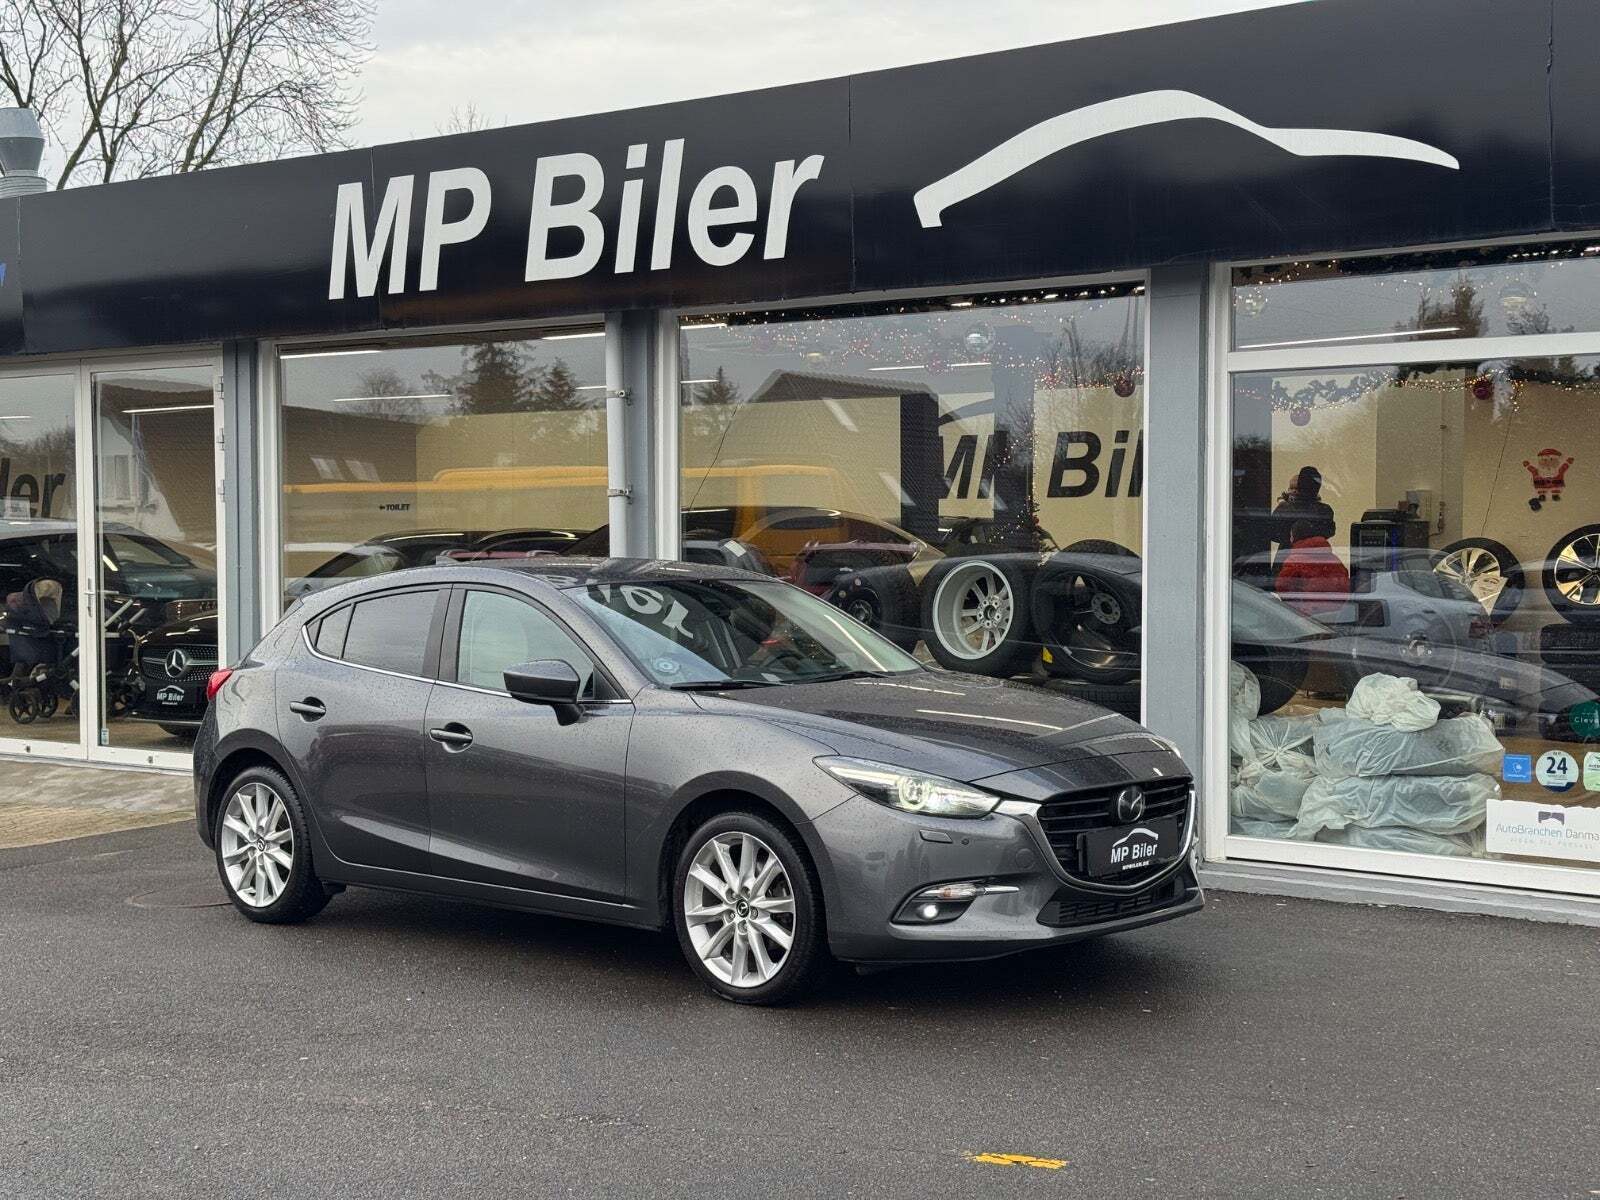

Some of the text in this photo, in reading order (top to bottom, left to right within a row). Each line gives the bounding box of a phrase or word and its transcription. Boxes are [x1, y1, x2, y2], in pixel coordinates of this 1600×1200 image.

[328, 138, 825, 300] MP Biler
[156, 692, 168, 701] MP
[1546, 756, 1568, 775] 24
[1495, 823, 1562, 838] AutoBranchen
[1110, 842, 1158, 864] MP Biler
